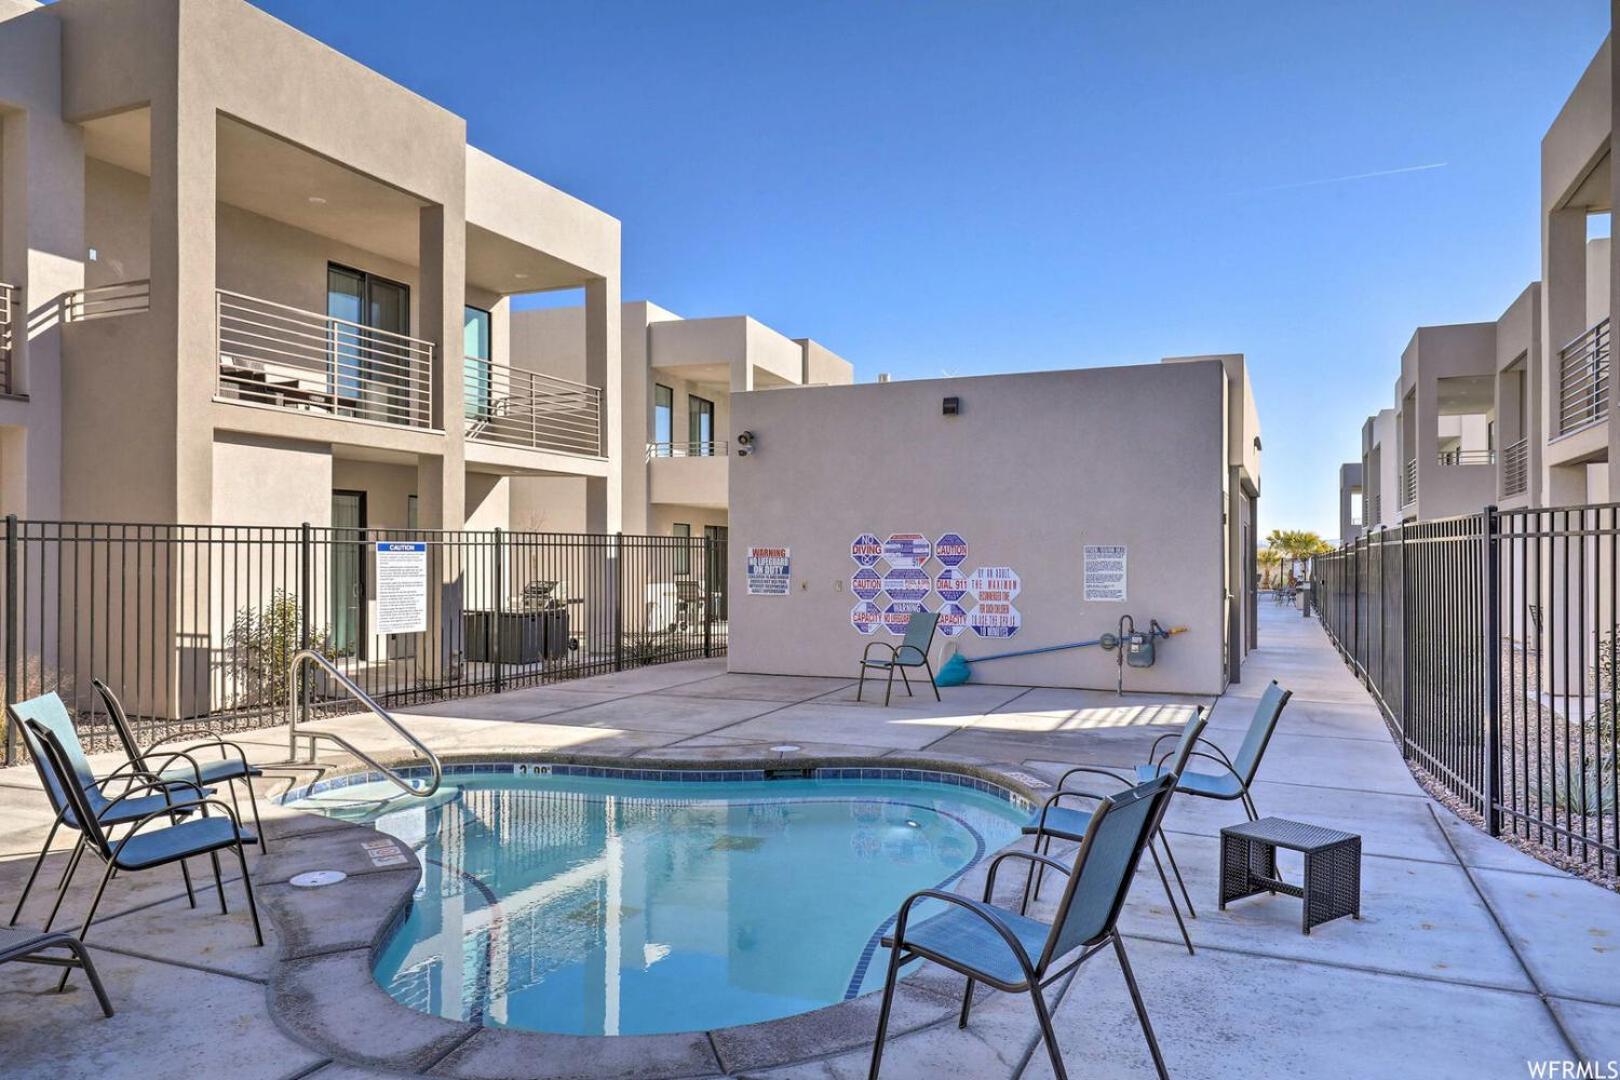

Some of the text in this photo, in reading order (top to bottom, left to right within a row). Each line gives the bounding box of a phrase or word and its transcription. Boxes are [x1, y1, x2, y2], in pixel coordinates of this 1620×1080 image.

[861, 534, 874, 544] NO
[389, 543, 415, 551] CAUTION
[852, 545, 881, 555] DIVING
[937, 545, 967, 555] CAUTION
[752, 548, 785, 557] WARNING
[853, 580, 881, 589] CAUTION
[936, 580, 952, 589] DIAL
[956, 580, 967, 589] 911
[853, 613, 881, 623] CAPACITY
